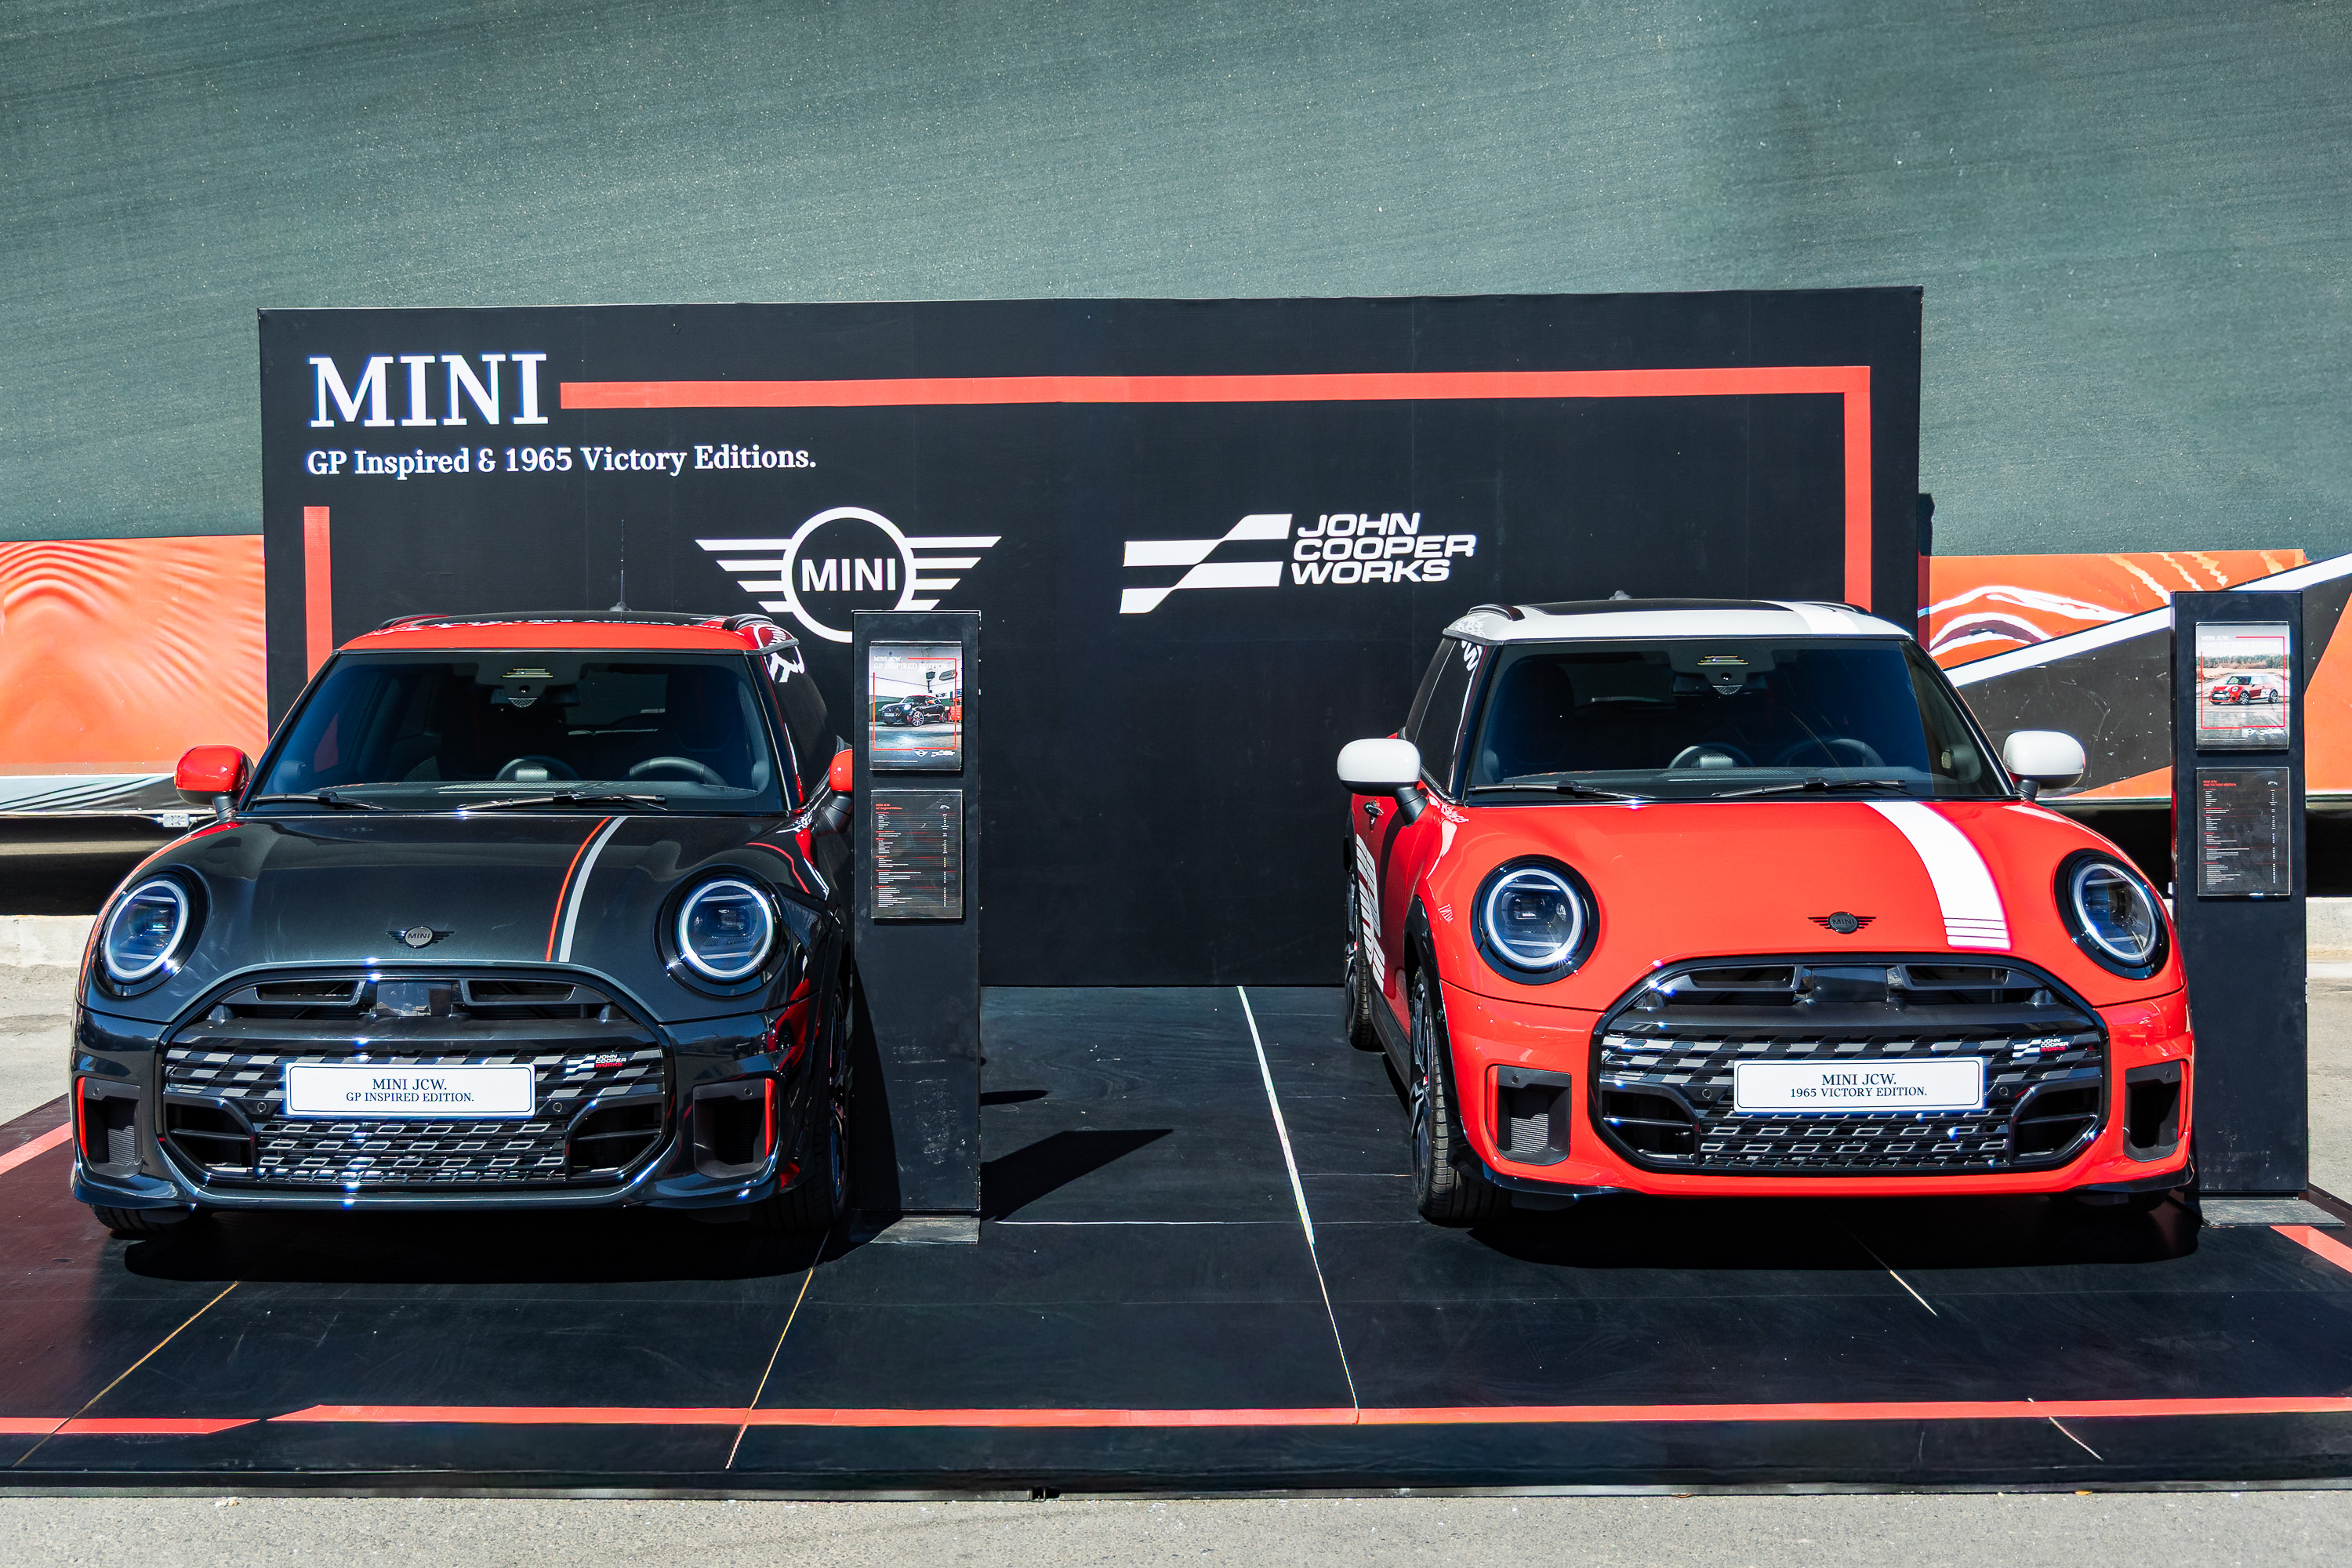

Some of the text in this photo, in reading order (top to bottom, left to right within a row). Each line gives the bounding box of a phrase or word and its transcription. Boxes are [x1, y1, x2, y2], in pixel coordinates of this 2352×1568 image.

[309, 353, 549, 428] MINI
[307, 443, 816, 481] GP Inspired & 1965 Victory Editions.
[1297, 512, 1421, 538] JOHN
[1293, 534, 1477, 562] COOPER
[801, 557, 896, 592] MINI
[1291, 559, 1451, 585] WORKS
[372, 1079, 448, 1091] MINI JCW.
[1791, 1087, 1928, 1098] 1965 VICTORY EDITION.
[1822, 1073, 1897, 1086] MINI JCW.
[346, 1092, 475, 1102] GP INSPIRED EDITION.
